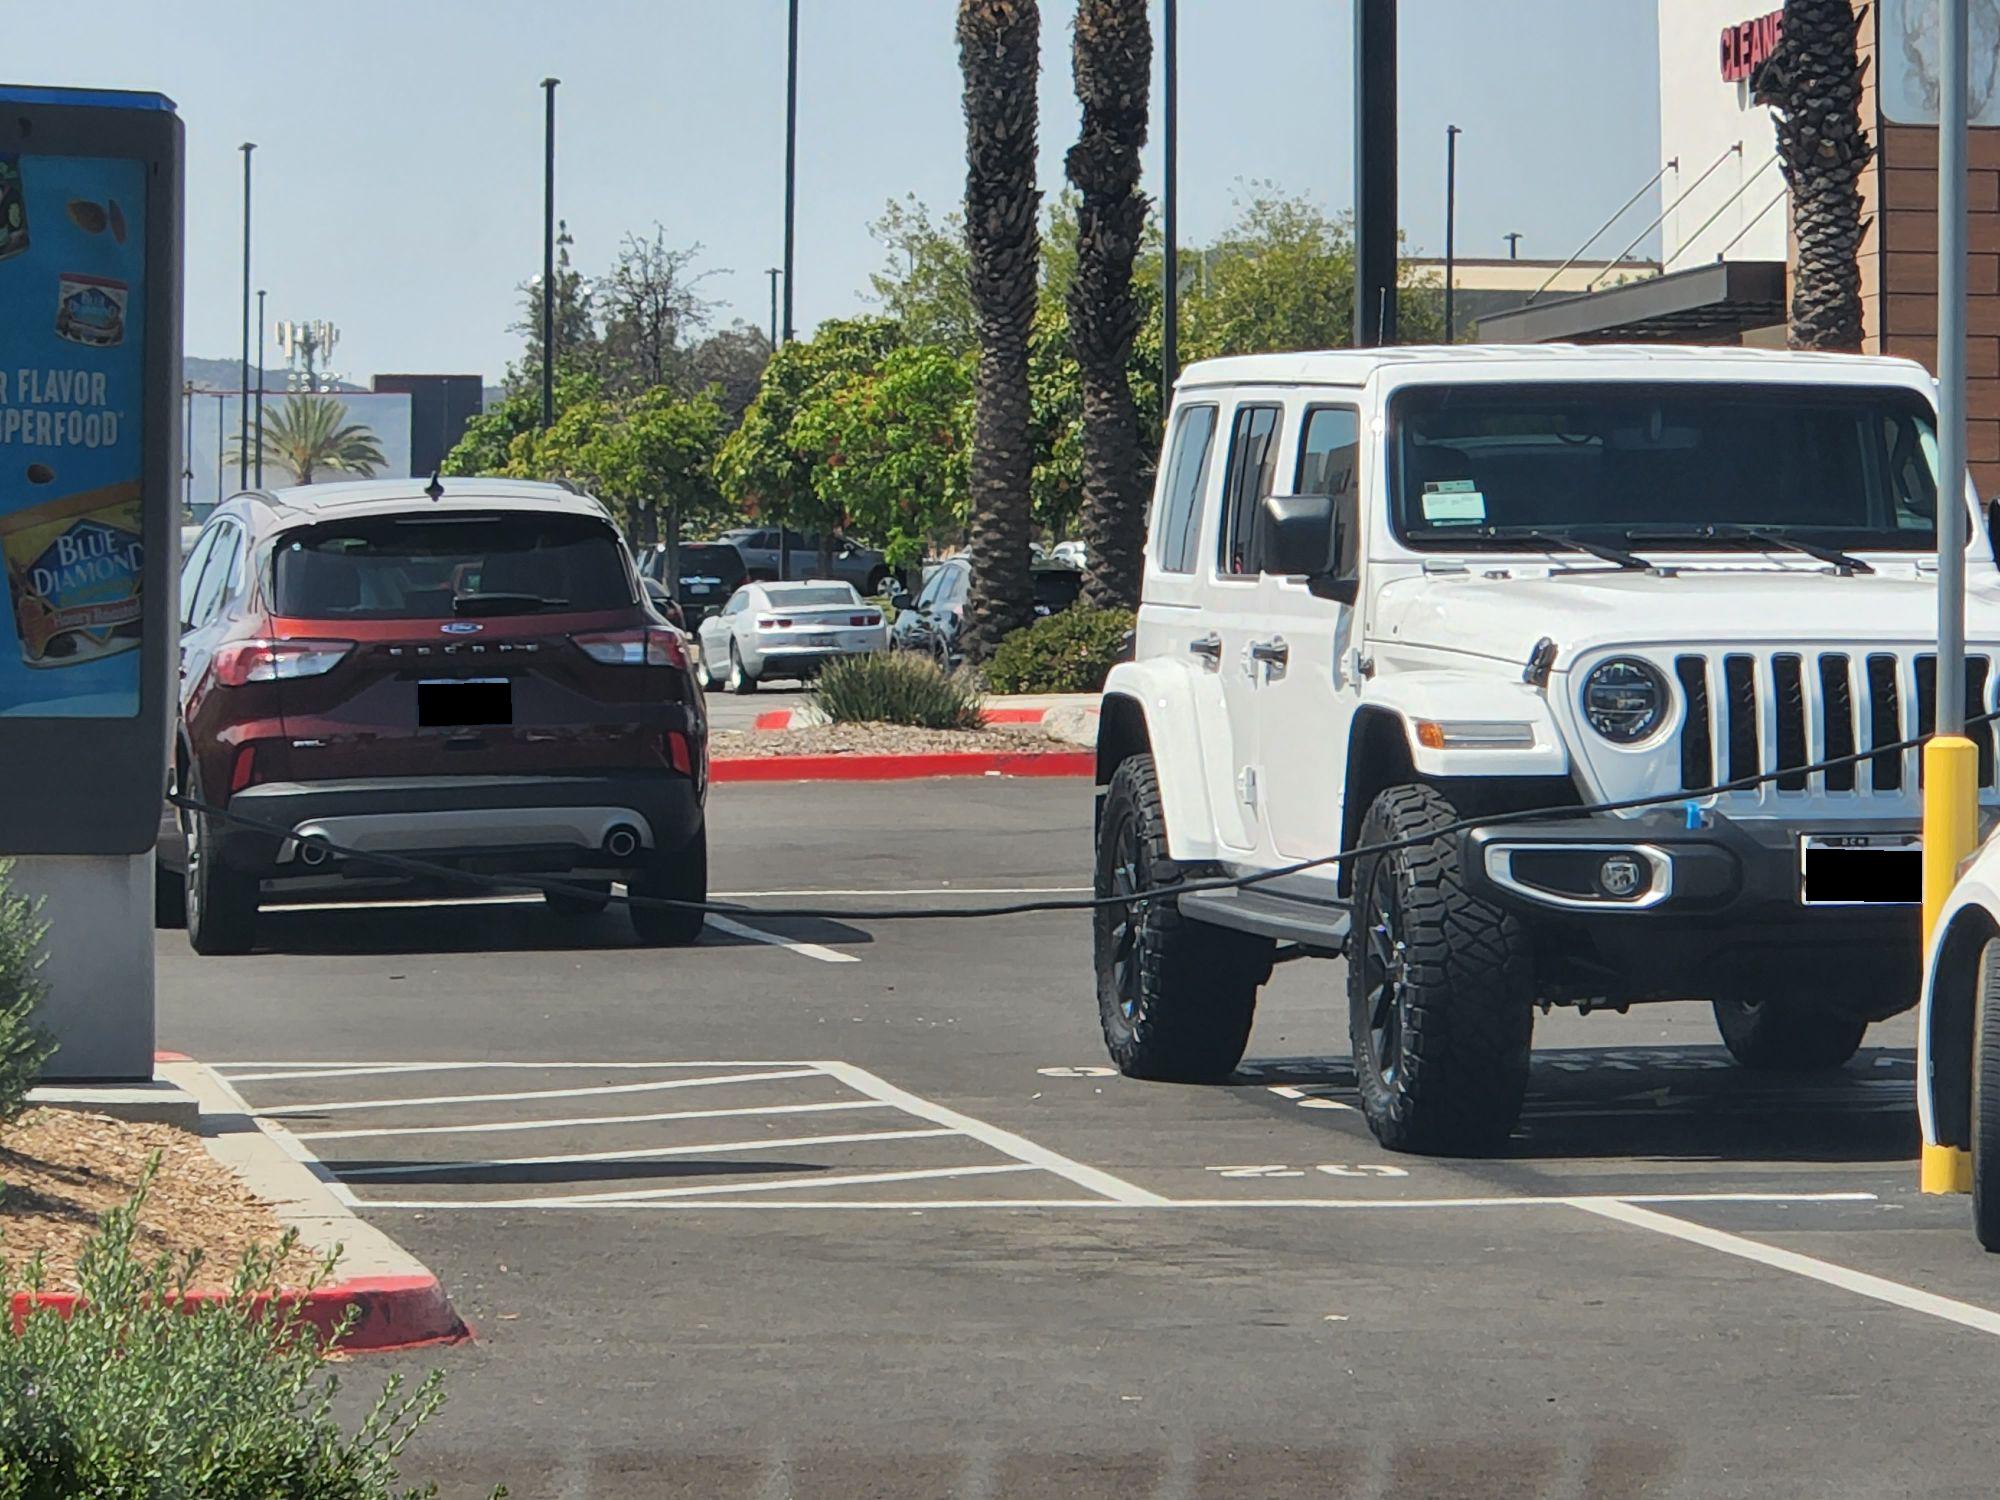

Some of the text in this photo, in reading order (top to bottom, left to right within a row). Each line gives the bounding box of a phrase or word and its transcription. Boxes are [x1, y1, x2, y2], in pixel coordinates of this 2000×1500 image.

[18, 369, 107, 406] FLAVOR
[0, 408, 118, 448] PERFOOD
[57, 529, 119, 566] BLUE
[33, 542, 144, 597] DIAMOND
